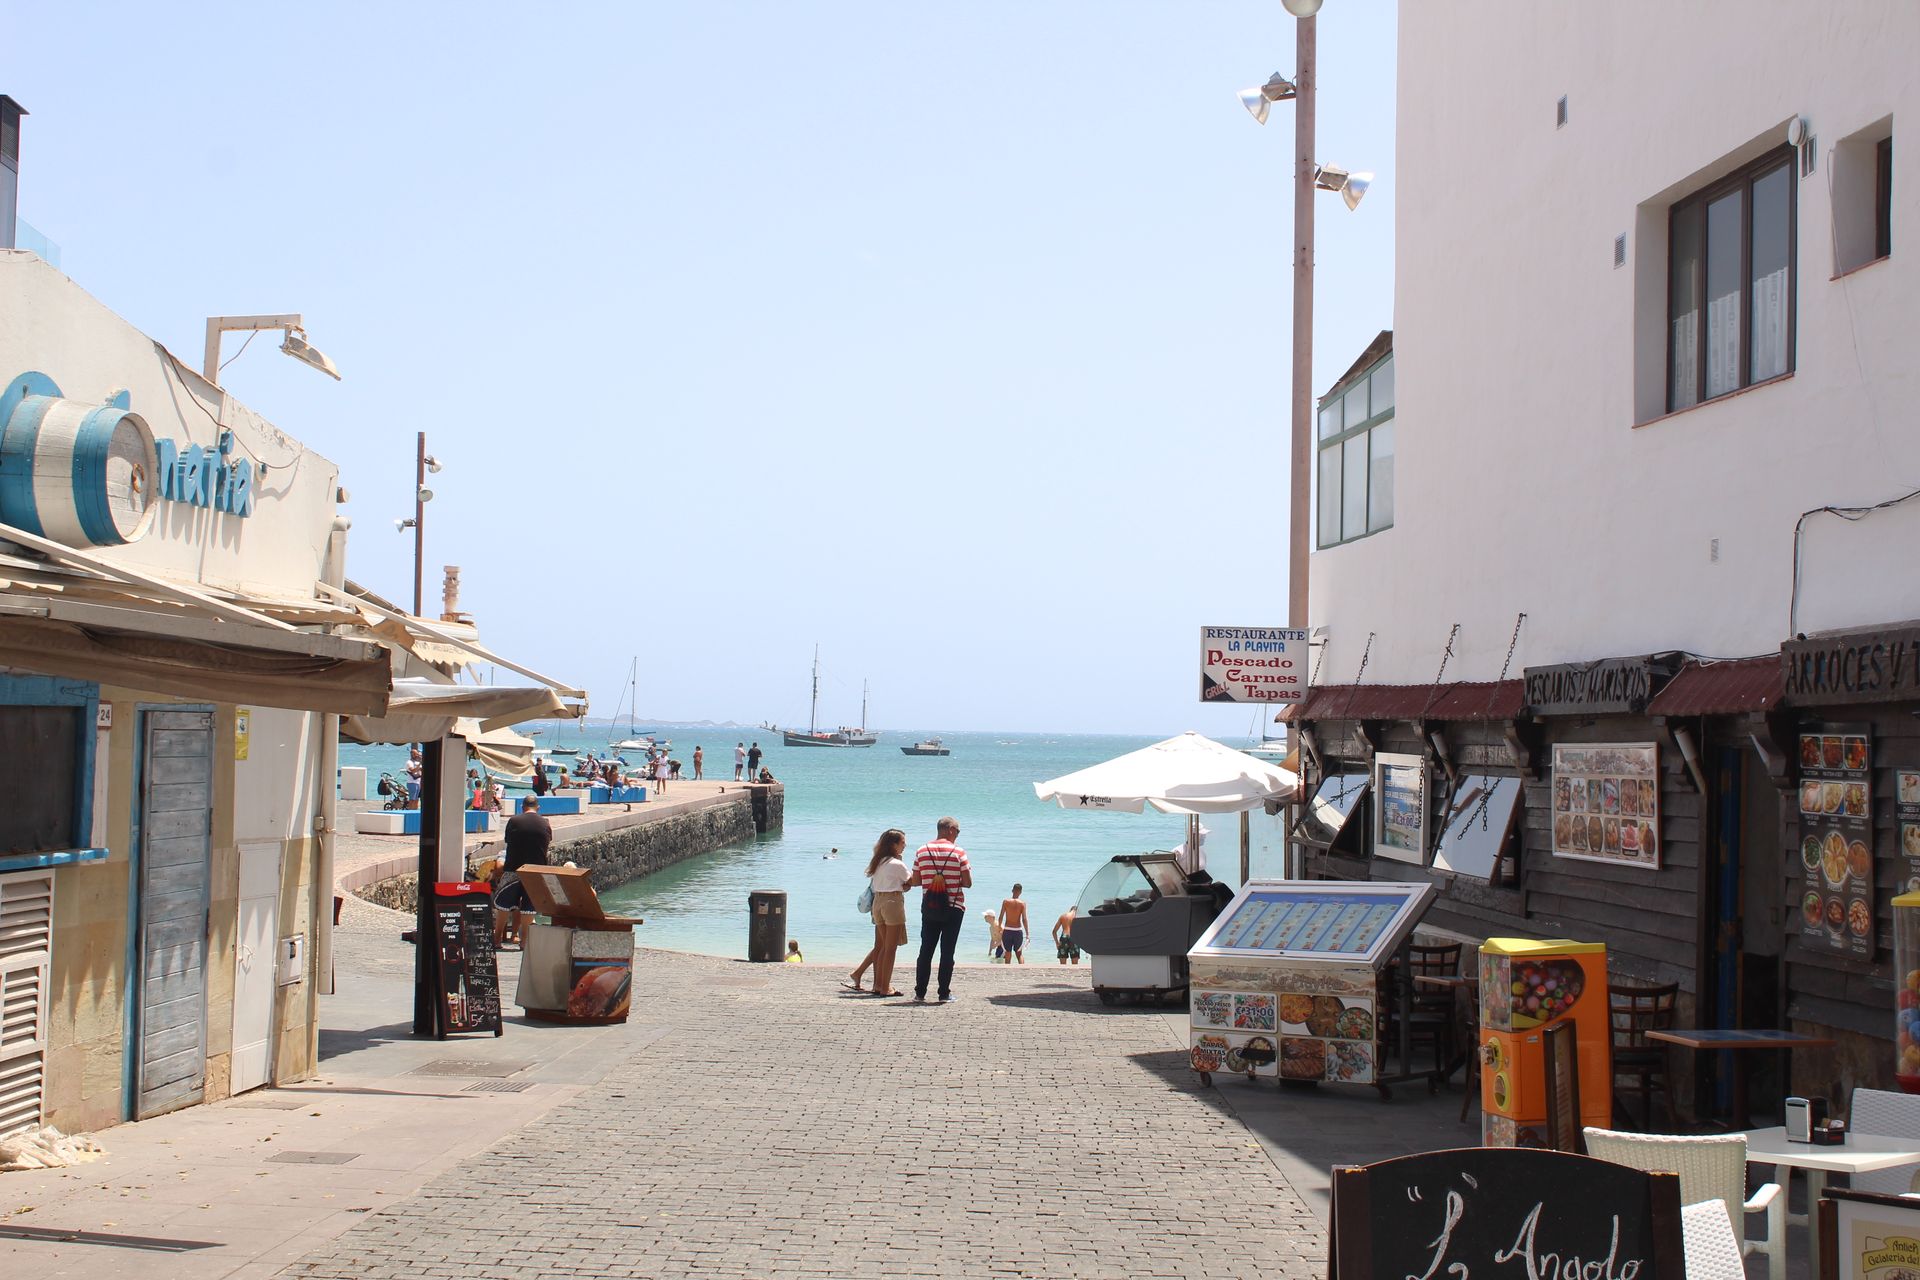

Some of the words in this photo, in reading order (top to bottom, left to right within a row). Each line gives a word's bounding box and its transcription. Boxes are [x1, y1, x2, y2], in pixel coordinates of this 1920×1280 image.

[1206, 628, 1305, 641] RESTAURANTE
[1228, 640, 1240, 651] LA
[1244, 641, 1285, 653] PLAYITA
[1207, 650, 1293, 669] Pescado
[1226, 669, 1298, 684] Carnes
[1785, 644, 1883, 694] ARROCES
[1205, 682, 1230, 699] GRILL
[1587, 667, 1647, 703] MARISCOS
[1244, 685, 1302, 701] Tapas
[101, 709, 111, 720] 24
[1200, 1048, 1226, 1056] MIXTAS
[1868, 1253, 1905, 1266] Gelateria
